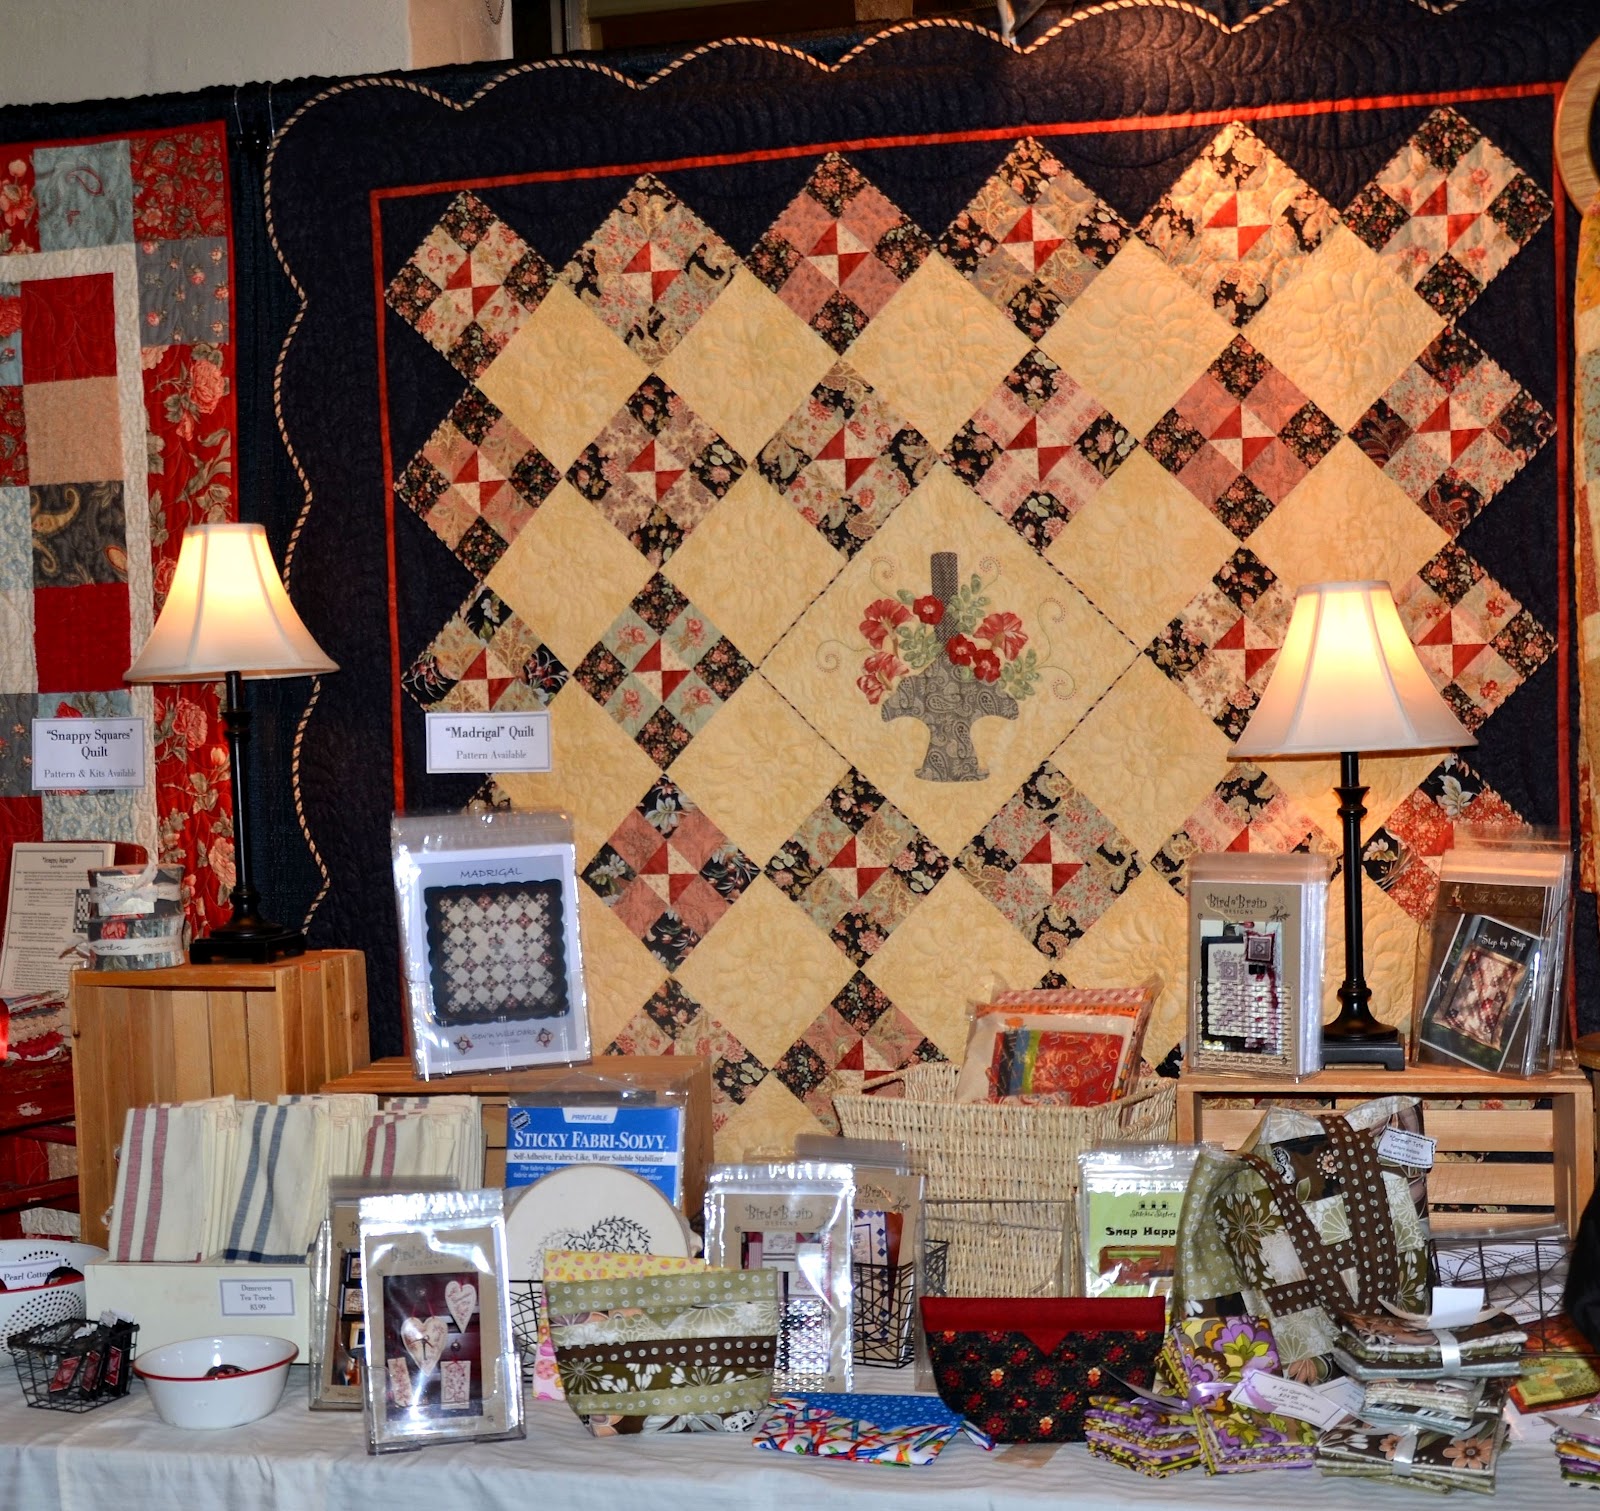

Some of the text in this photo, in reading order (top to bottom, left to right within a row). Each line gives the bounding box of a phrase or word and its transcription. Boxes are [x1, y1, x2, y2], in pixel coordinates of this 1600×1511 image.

[508, 725, 535, 740] Quilt
[81, 746, 108, 760] Quilt
[456, 749, 527, 760] Pattern Available
[44, 768, 136, 778] Pattern & Kits Available
[460, 867, 523, 879] MADRIGAL
[1206, 893, 1267, 909] Bird Brain
[1499, 937, 1508, 950] by
[514, 1130, 667, 1150] STICKY FABRI-SOLVY
[513, 1152, 664, 1163] Self-Adhesive, Fabric-Like, Water Soluble Stabilizer
[744, 1204, 813, 1220] Bird Bain
[1105, 1226, 1177, 1239] Snap Happ
[4, 1272, 24, 1281] Pearl
